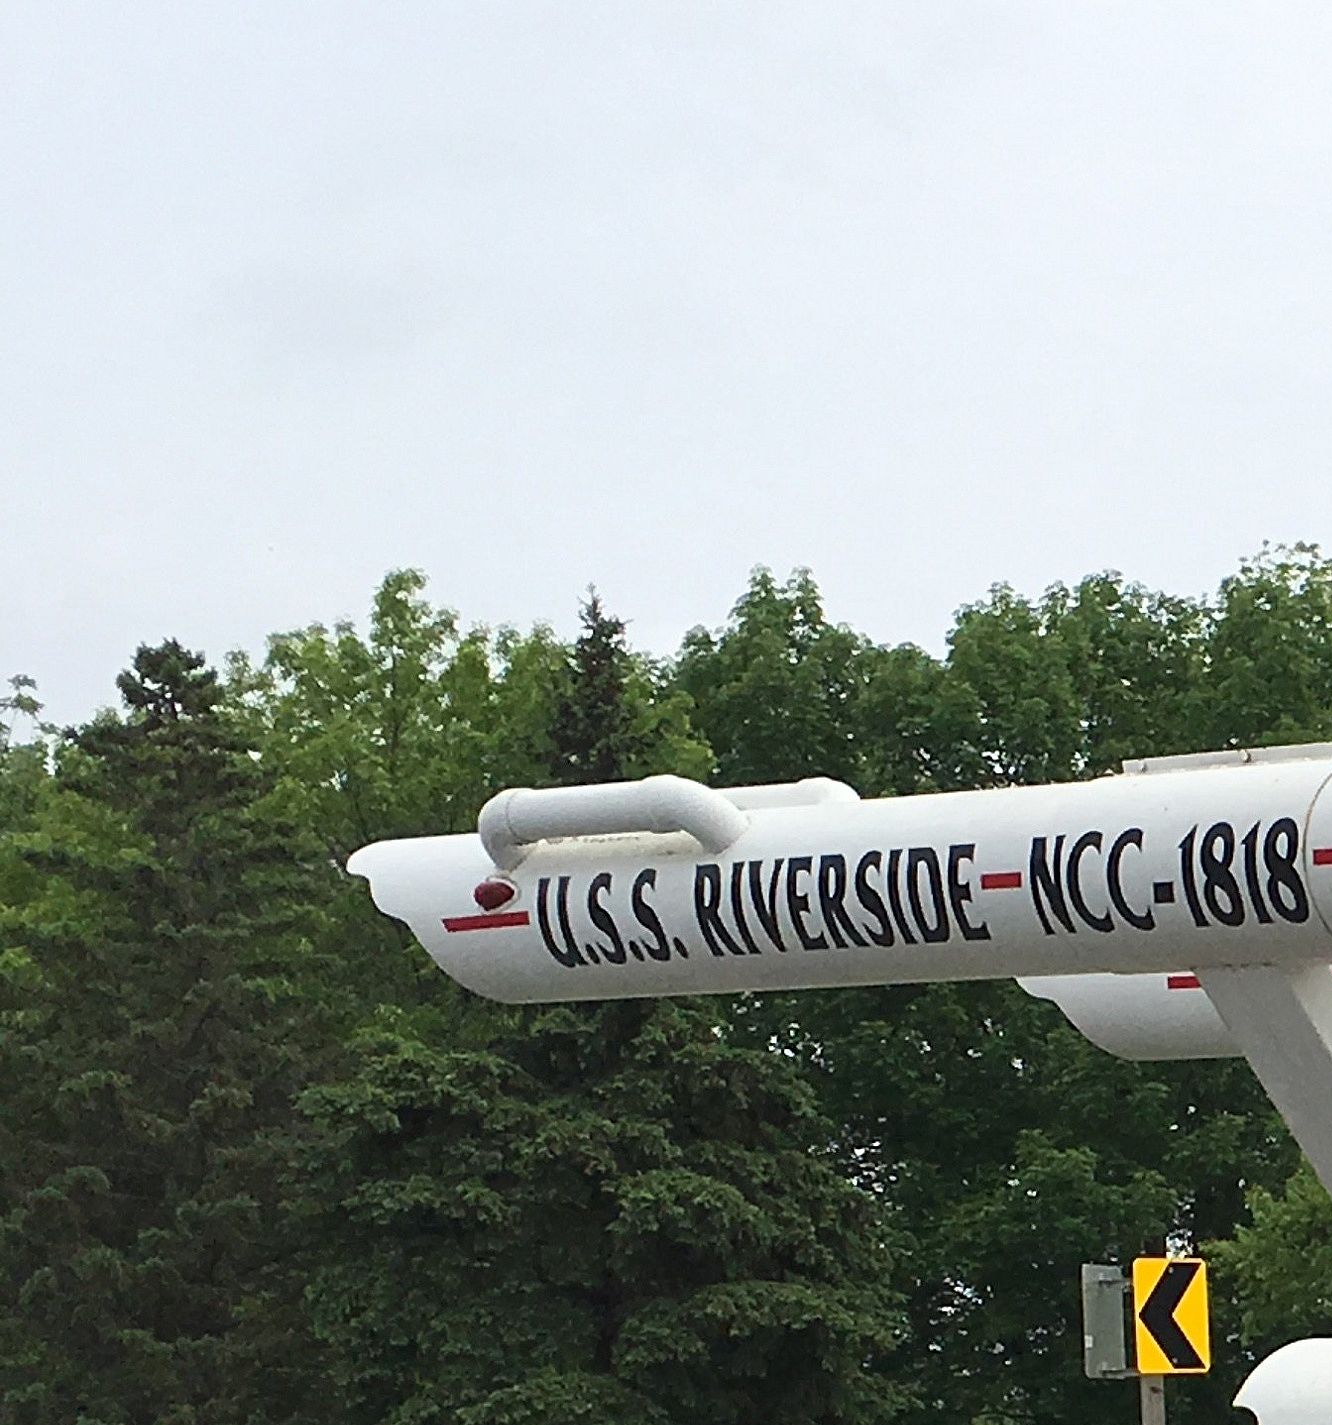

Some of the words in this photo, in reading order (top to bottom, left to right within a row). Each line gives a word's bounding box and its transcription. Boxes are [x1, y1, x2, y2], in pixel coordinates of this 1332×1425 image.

[537, 868, 689, 968] U.S.S.
[695, 842, 990, 958] RIVERSIDE
[1029, 815, 1310, 936] NCC-1818
